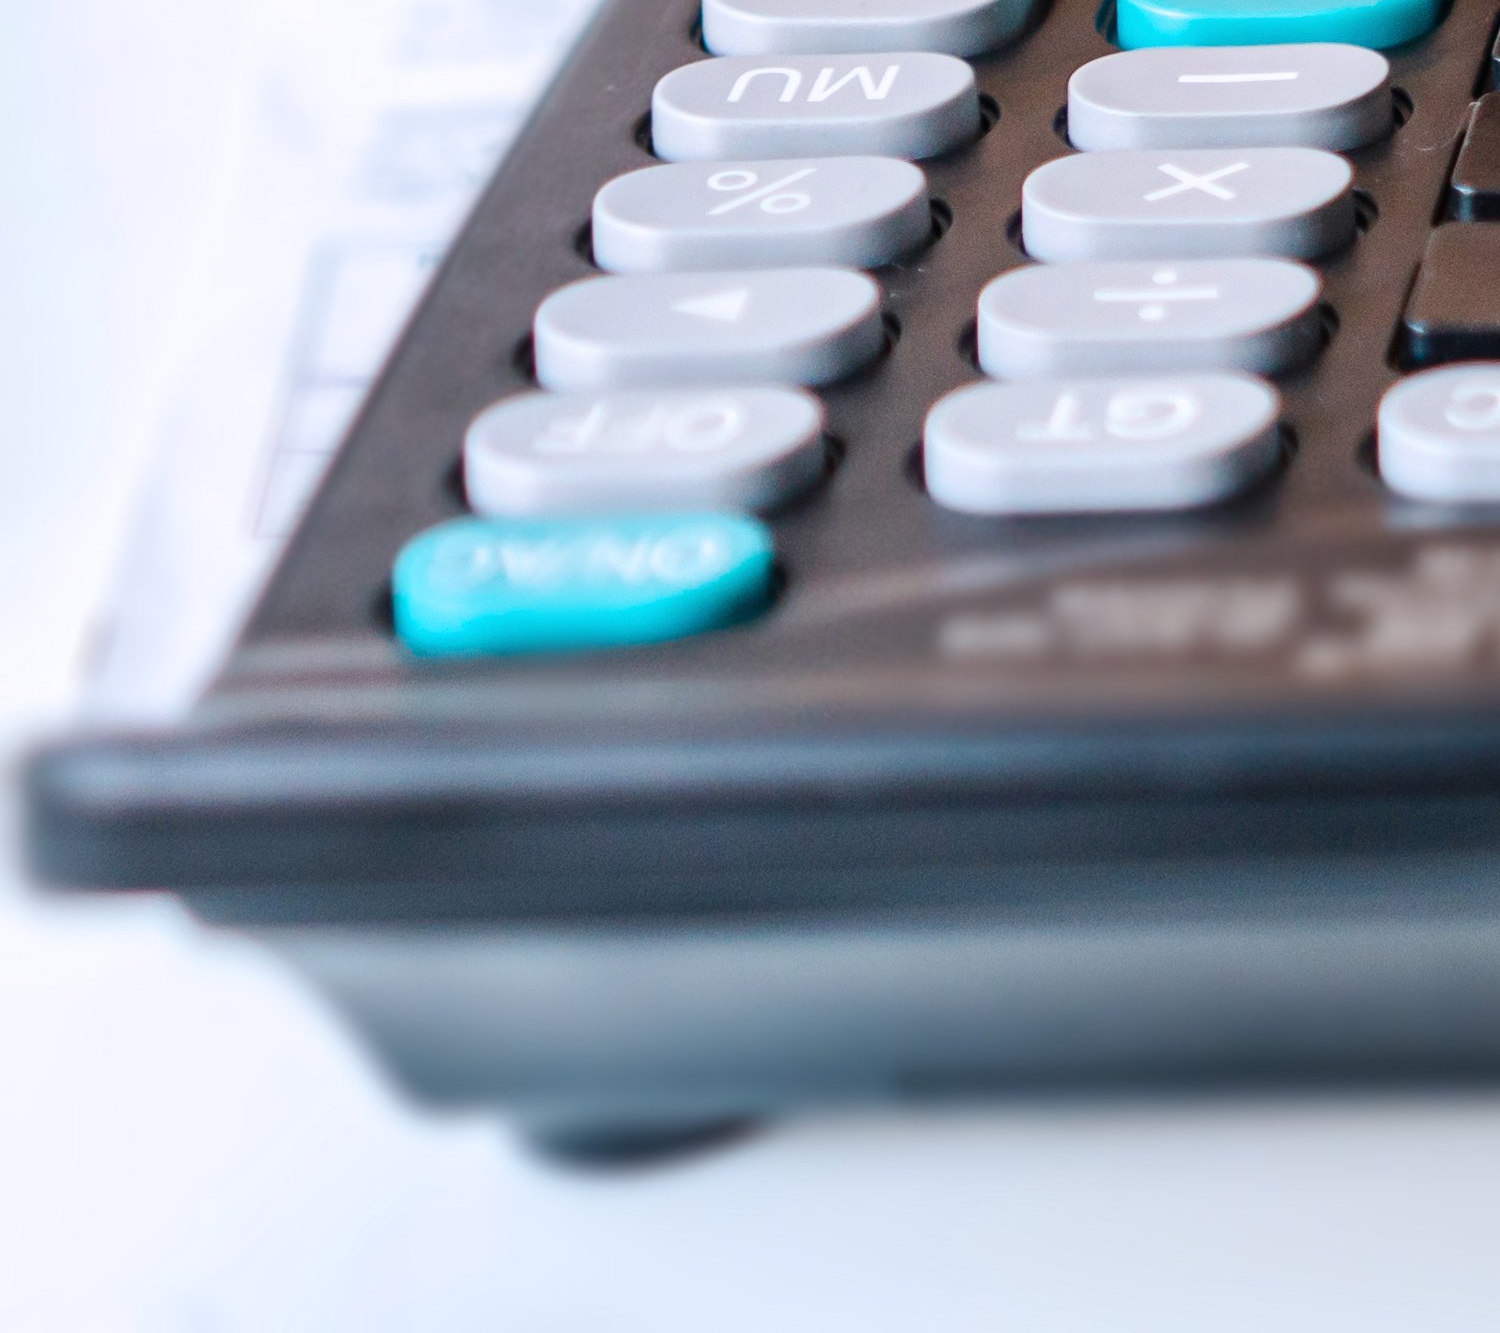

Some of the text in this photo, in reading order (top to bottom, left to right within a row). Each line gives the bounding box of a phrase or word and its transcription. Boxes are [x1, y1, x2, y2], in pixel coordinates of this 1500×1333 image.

[728, 64, 900, 103] MU
[707, 169, 817, 218] %
[533, 396, 747, 454] OFF
[1017, 391, 1195, 439] GT
